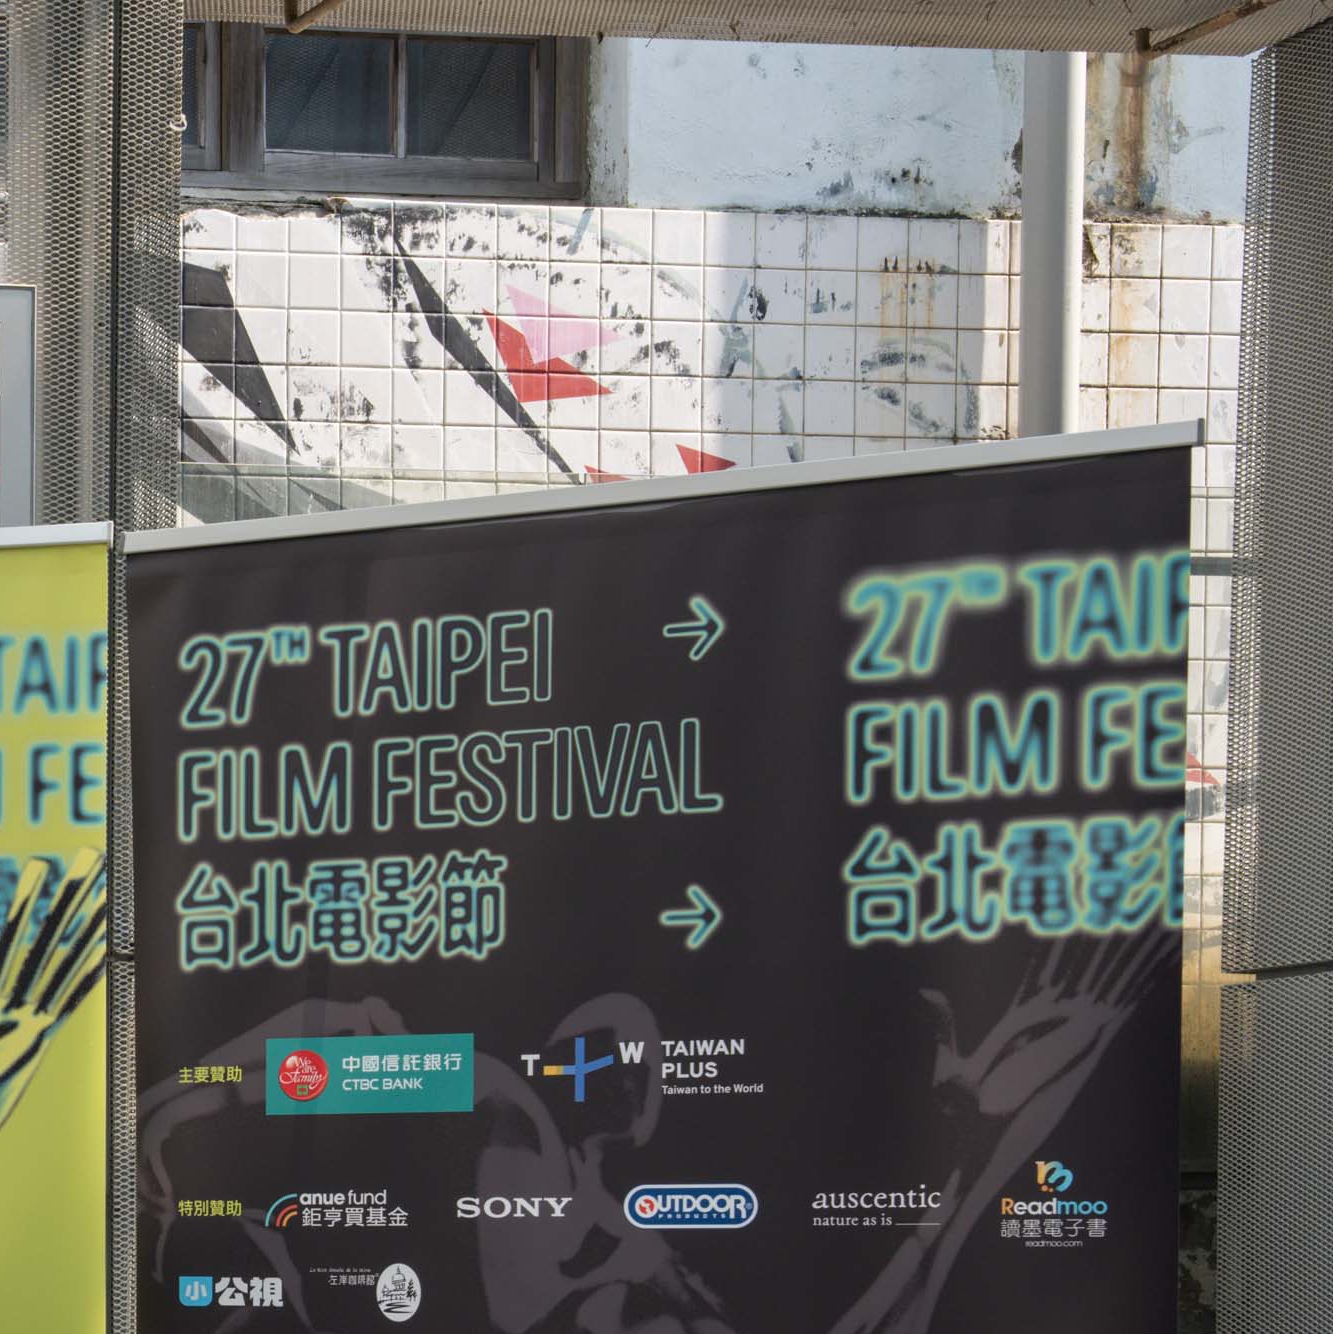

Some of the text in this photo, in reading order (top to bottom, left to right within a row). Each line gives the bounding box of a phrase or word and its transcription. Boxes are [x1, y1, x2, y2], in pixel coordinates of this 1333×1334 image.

[319, 608, 555, 718] TAIPEI
[845, 690, 1060, 806] FILM
[178, 717, 725, 842] FILM FESTIVAL
[843, 818, 1186, 950] 台北電影
[176, 850, 509, 973] 台北電影節
[660, 1038, 745, 1058] TAIWAN
[342, 1053, 463, 1073] 中國信託銀行
[660, 1061, 719, 1080] PLUS
[178, 1066, 243, 1084] 主要贊助
[342, 1077, 424, 1091] CTBC BANK
[661, 1082, 765, 1096] Taiwan World
[299, 1189, 387, 1206] anue fund
[811, 1184, 941, 1210] auscentic
[1000, 1197, 1108, 1216] Readmoo
[178, 1199, 242, 1218] 特別贊助
[456, 1196, 572, 1219] SONY
[813, 1214, 860, 1227] nature
[1000, 1218, 1108, 1239] 讀墨電子書
